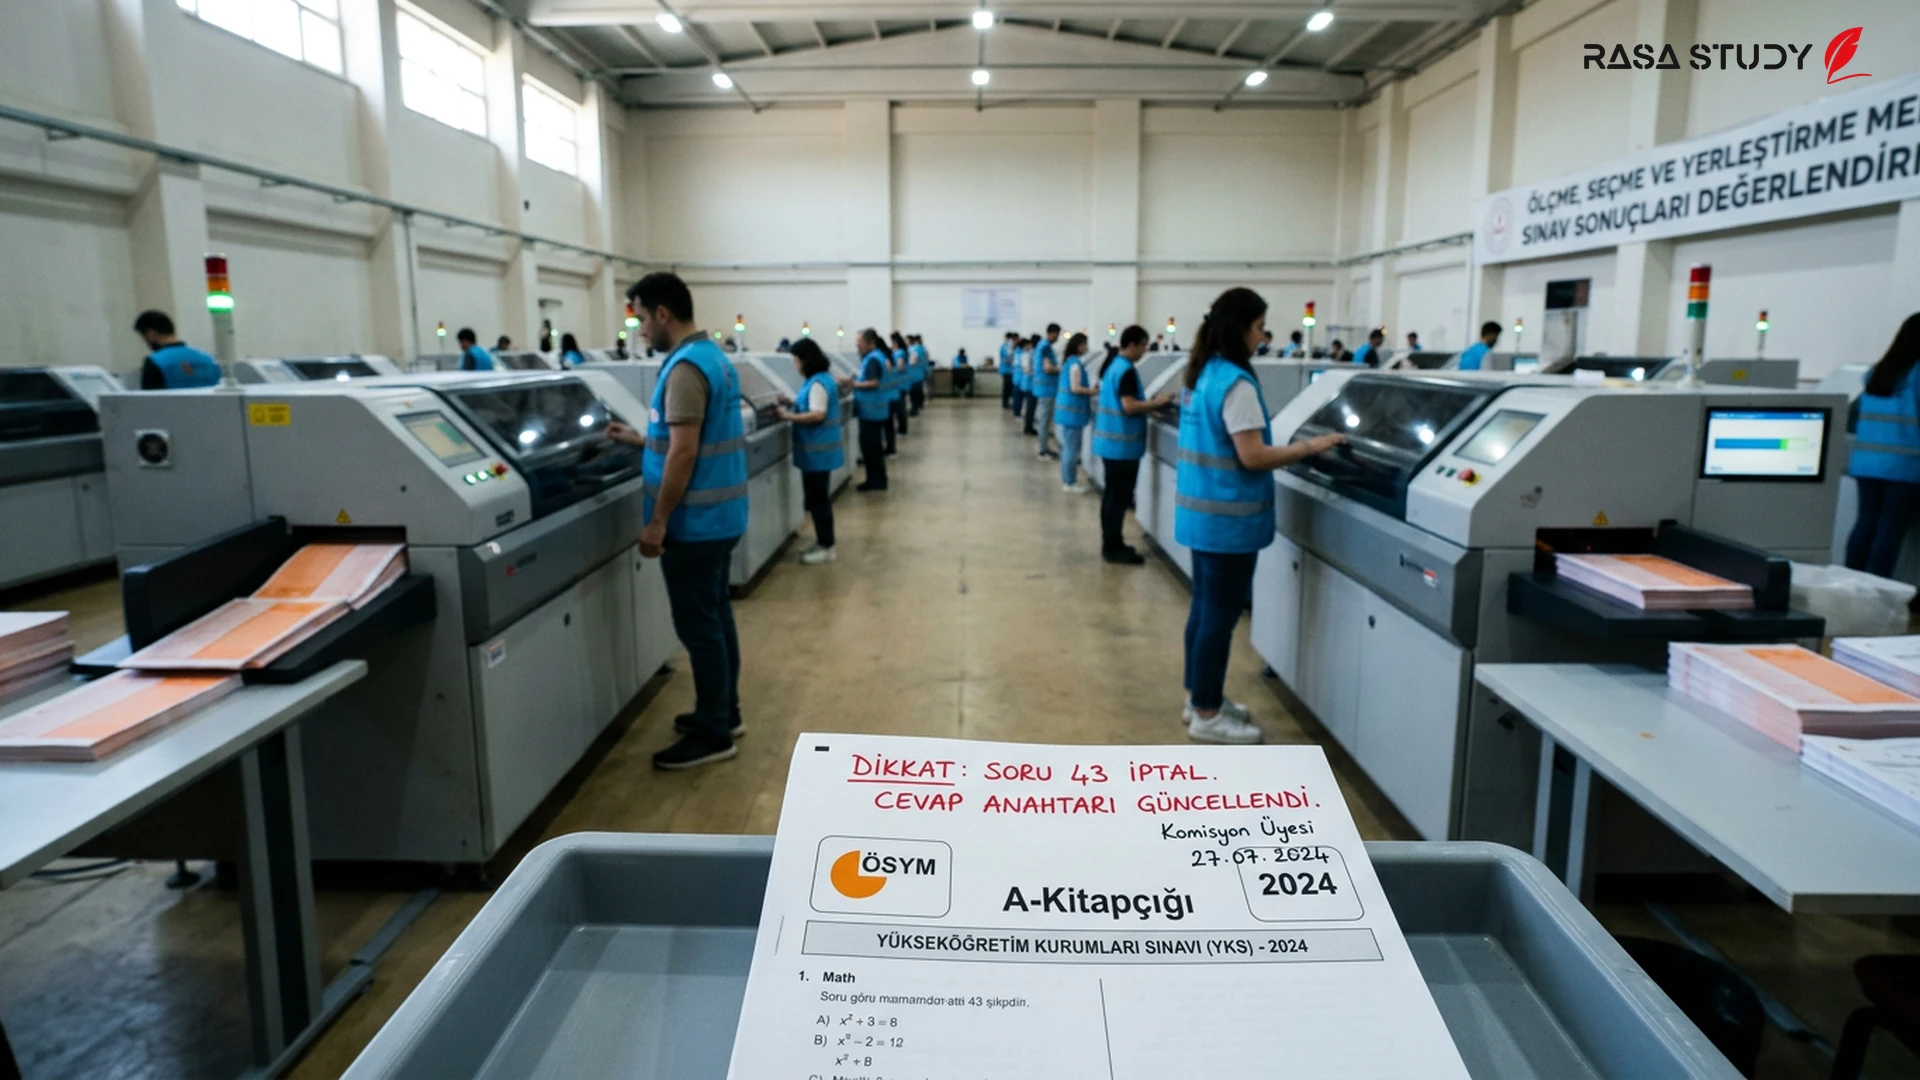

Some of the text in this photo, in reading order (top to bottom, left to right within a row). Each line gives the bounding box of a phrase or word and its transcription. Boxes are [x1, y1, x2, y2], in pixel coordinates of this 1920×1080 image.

[1528, 94, 1920, 214] ÖLÇME, SEÇME VE YERLEŞTİRME ME
[1522, 217, 1571, 246] SINAV
[1575, 192, 1691, 234] SONUÇLARI
[1697, 139, 1920, 216] DEĞERLENDİR
[852, 754, 1217, 786] DİKKAT: SORU 43 İPTAL.
[875, 786, 1320, 814] CEVAP ANAHTARI GÜNCELLENDİ.
[1161, 815, 1315, 846] Komisyon Üyesi
[861, 851, 937, 876] ÖSYM
[1259, 872, 1337, 895] 2024
[1003, 887, 1193, 920] A-Kitapçığı
[877, 931, 1028, 952] YÜKSEKÖĞRETİM
[1035, 939, 1139, 954] KURUMLARI
[1145, 940, 1201, 954] SINAVI
[1207, 940, 1253, 956] (YKS)
[1268, 939, 1308, 953] 2024
[799, 970, 856, 984] 1. Math
[821, 990, 848, 1003] Soru
[968, 996, 984, 1007] 43
[816, 1014, 831, 1028] A)
[814, 1034, 828, 1048] B)
